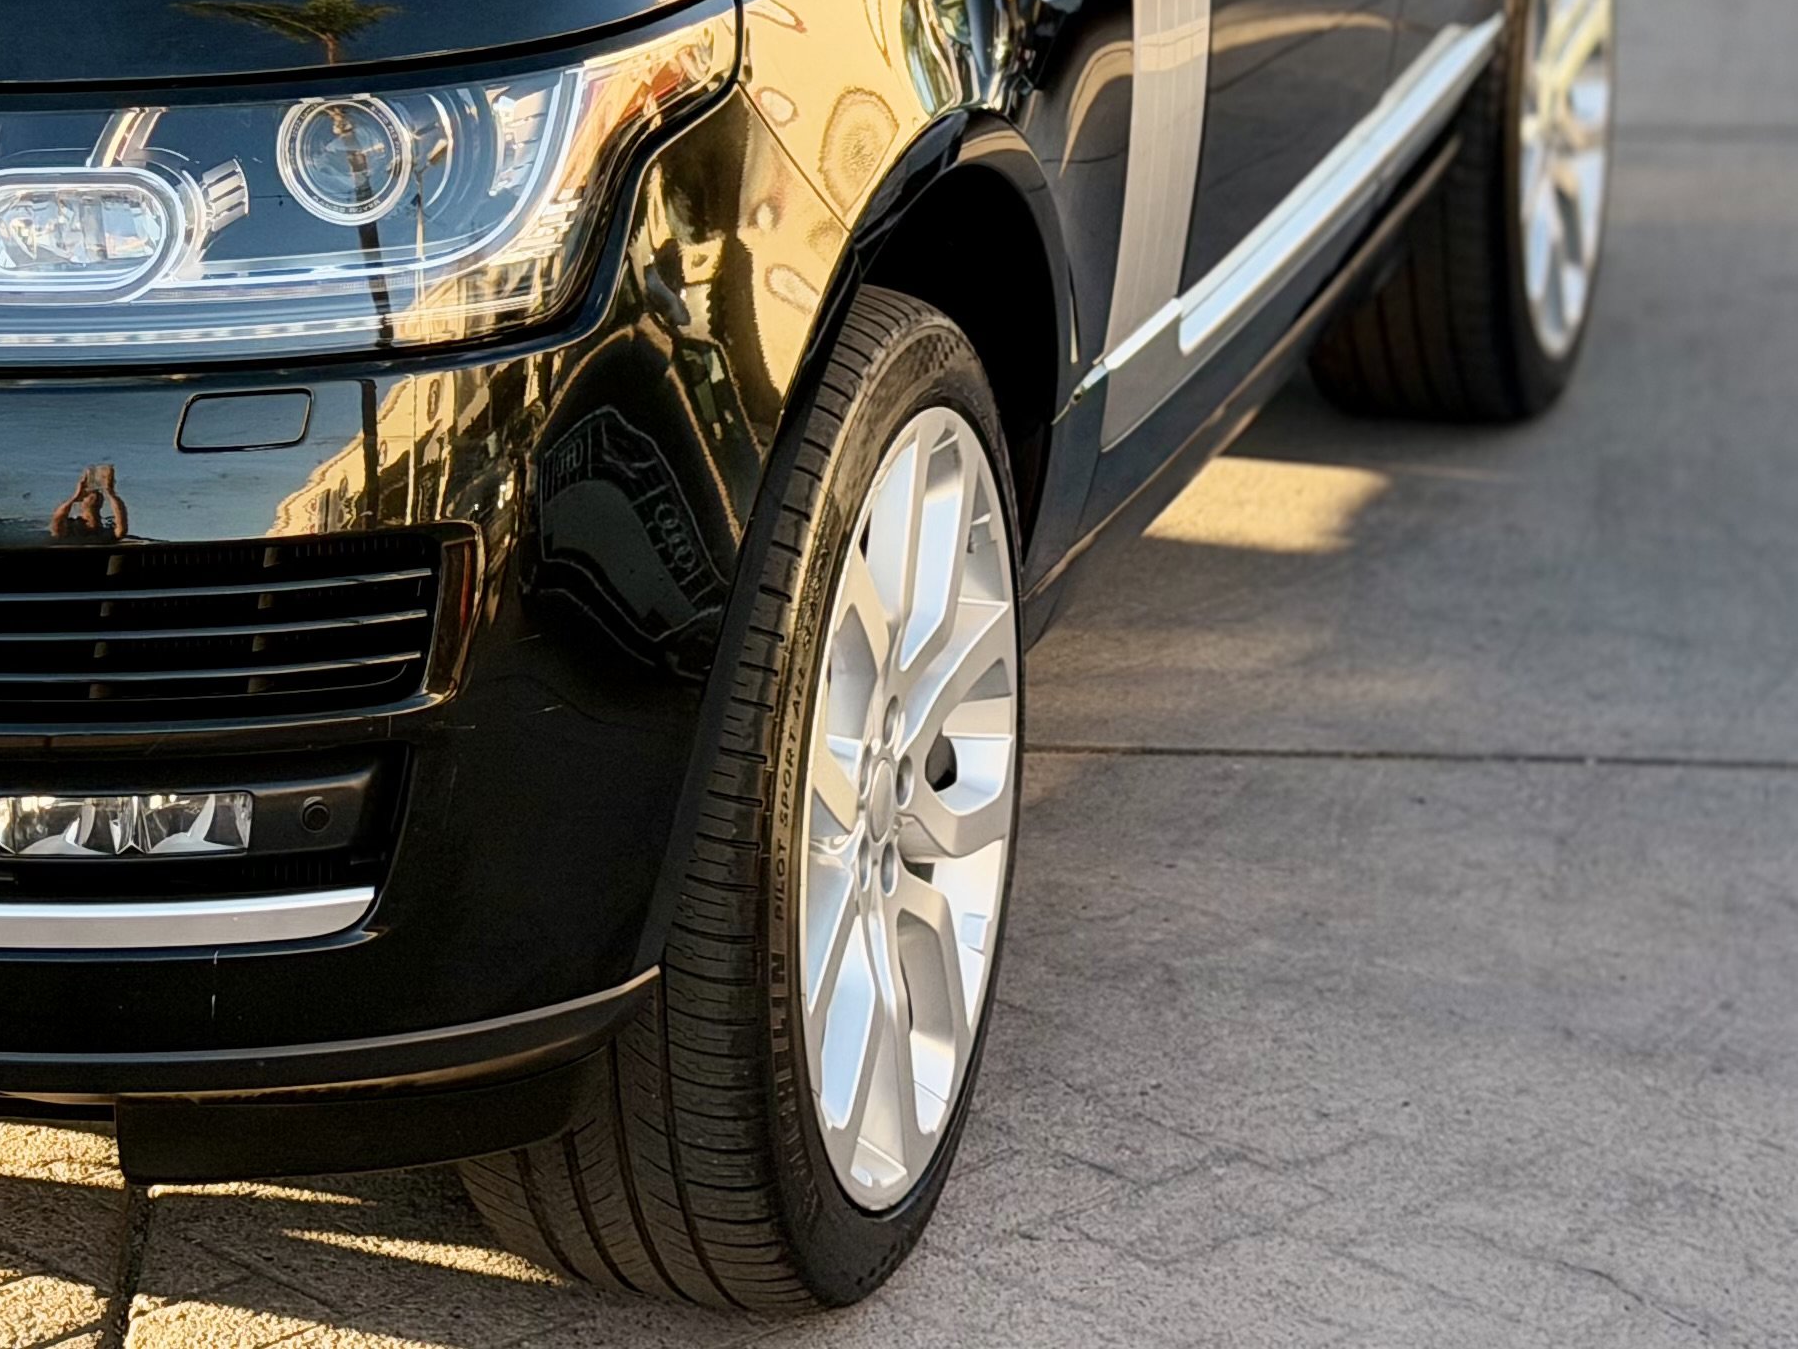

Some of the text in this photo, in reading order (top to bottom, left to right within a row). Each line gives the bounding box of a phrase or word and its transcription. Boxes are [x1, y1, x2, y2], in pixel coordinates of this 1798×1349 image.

[778, 729, 798, 829] SPORT
[774, 838, 788, 921] PILOT
[769, 951, 806, 1178] HELIN
